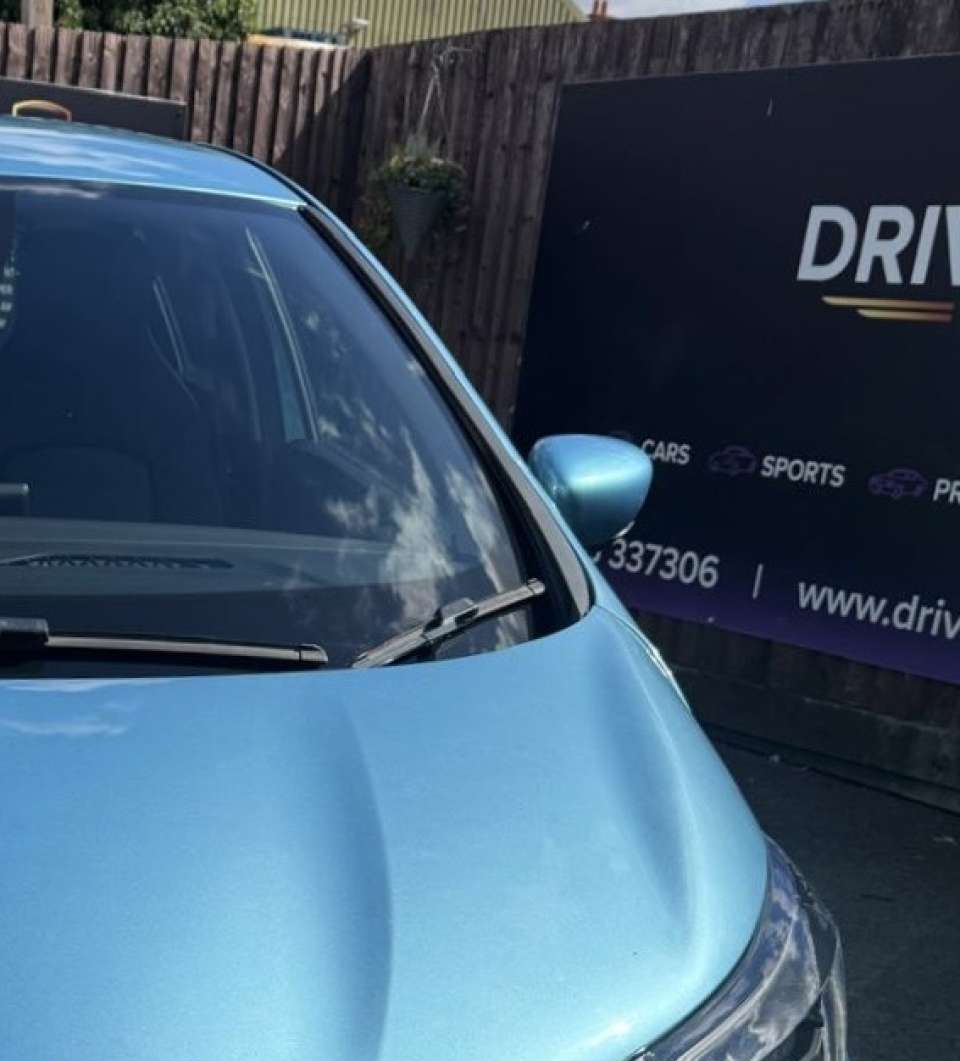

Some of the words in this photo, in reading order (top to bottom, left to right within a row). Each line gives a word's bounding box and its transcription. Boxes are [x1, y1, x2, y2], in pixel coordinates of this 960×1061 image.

[641, 439, 692, 466] CARS
[760, 455, 847, 488] SPORTS
[607, 537, 720, 589] 337306
